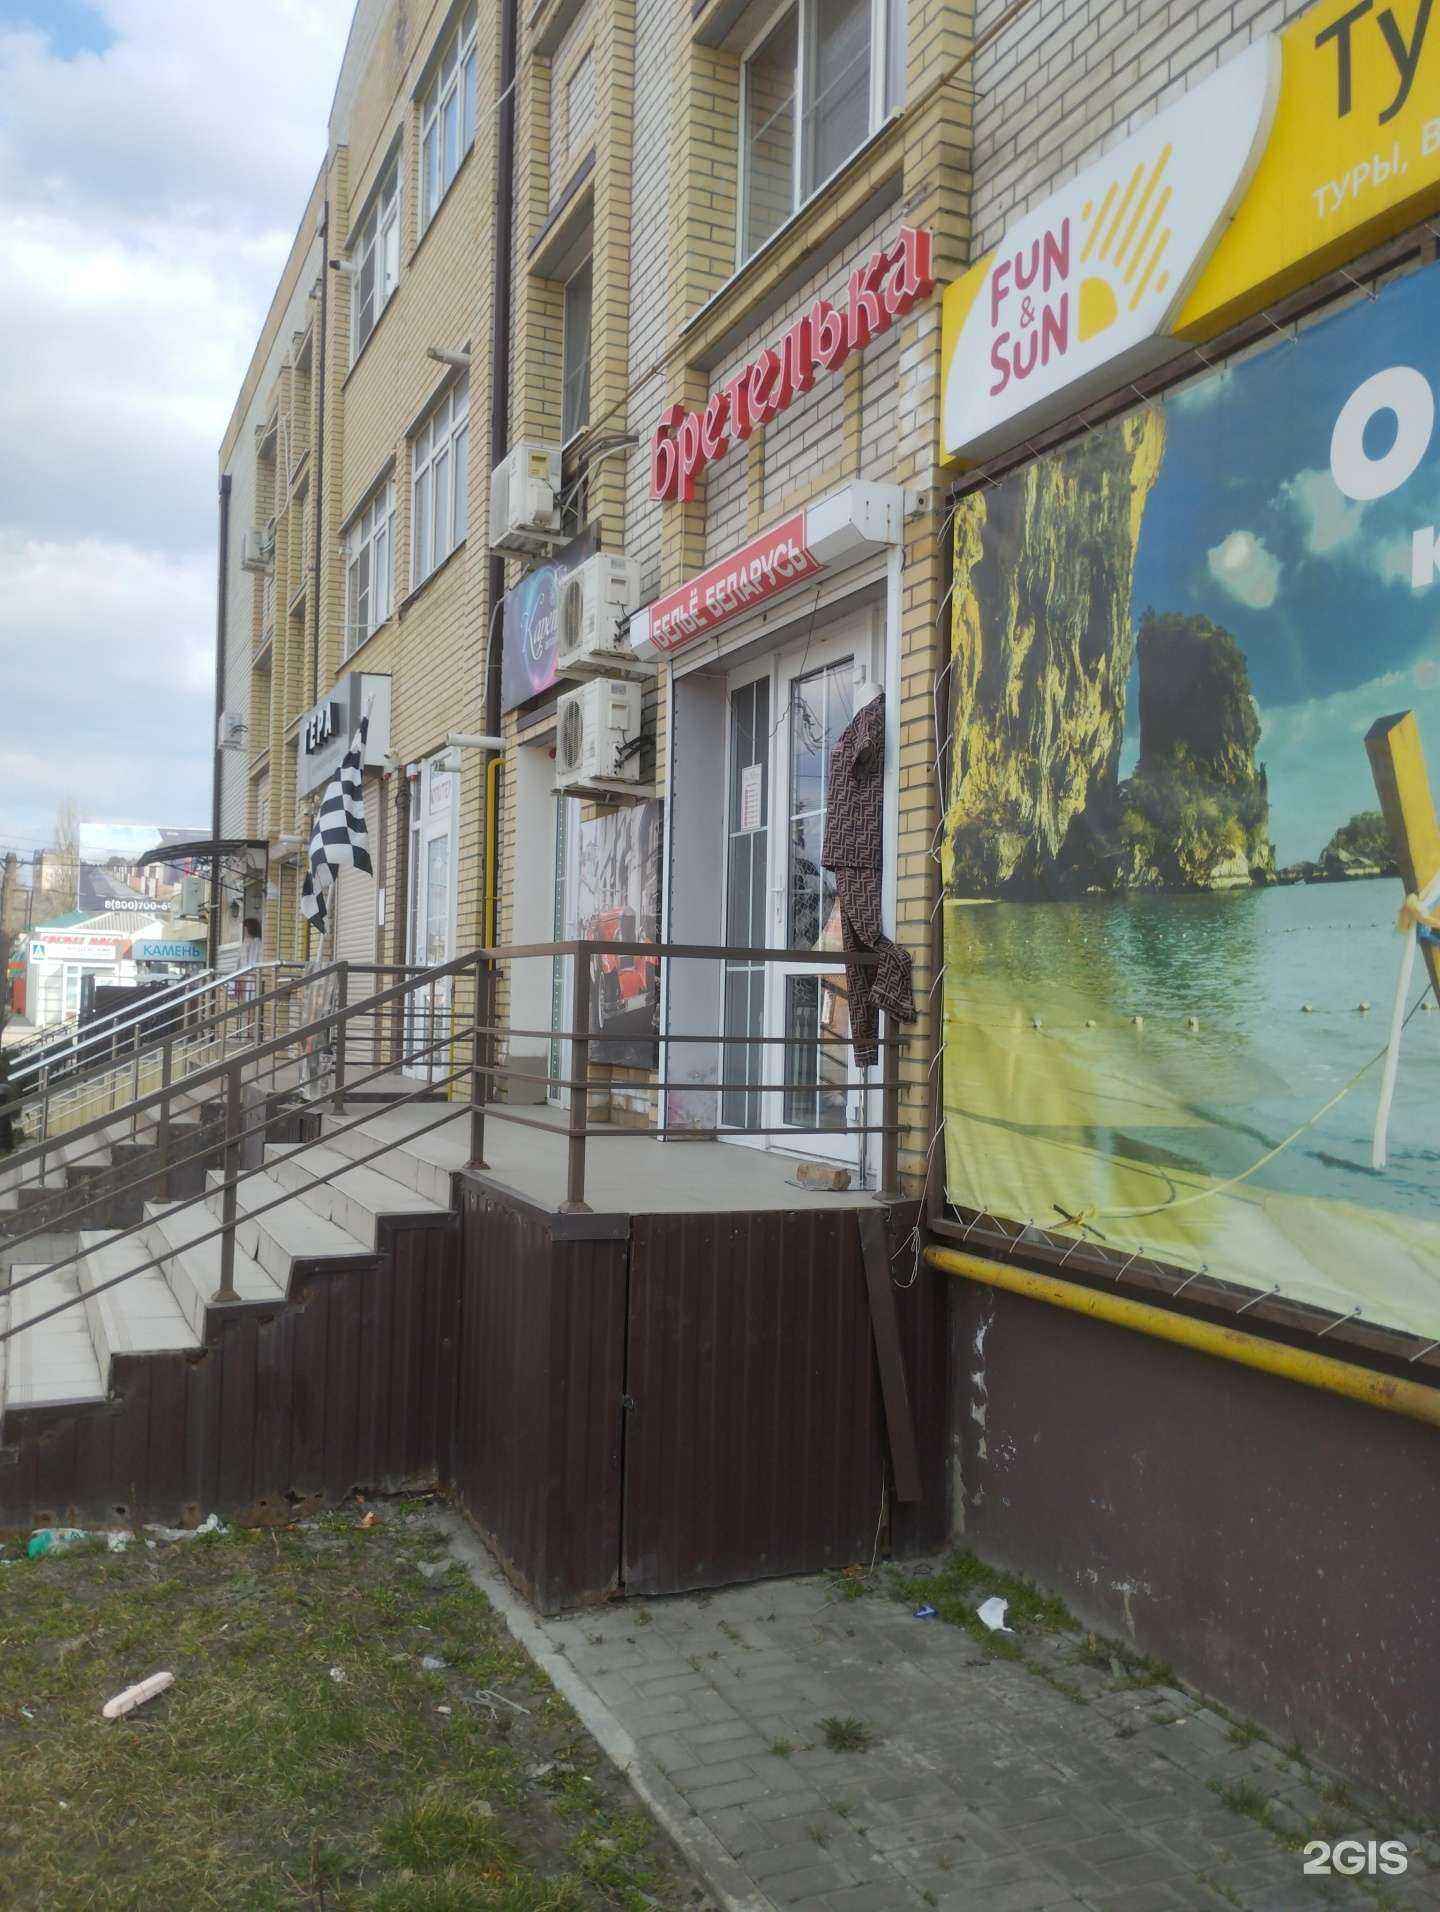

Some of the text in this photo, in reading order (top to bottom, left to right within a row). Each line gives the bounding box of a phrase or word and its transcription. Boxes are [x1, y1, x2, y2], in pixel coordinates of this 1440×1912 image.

[990, 217, 1070, 328] FUN
[1019, 295, 1036, 329] &
[989, 292, 1069, 397] SUN
[653, 537, 808, 648] БЕЛЬЁ БЕЛАРУСЬ
[143, 943, 201, 958] КАМЕНЬ
